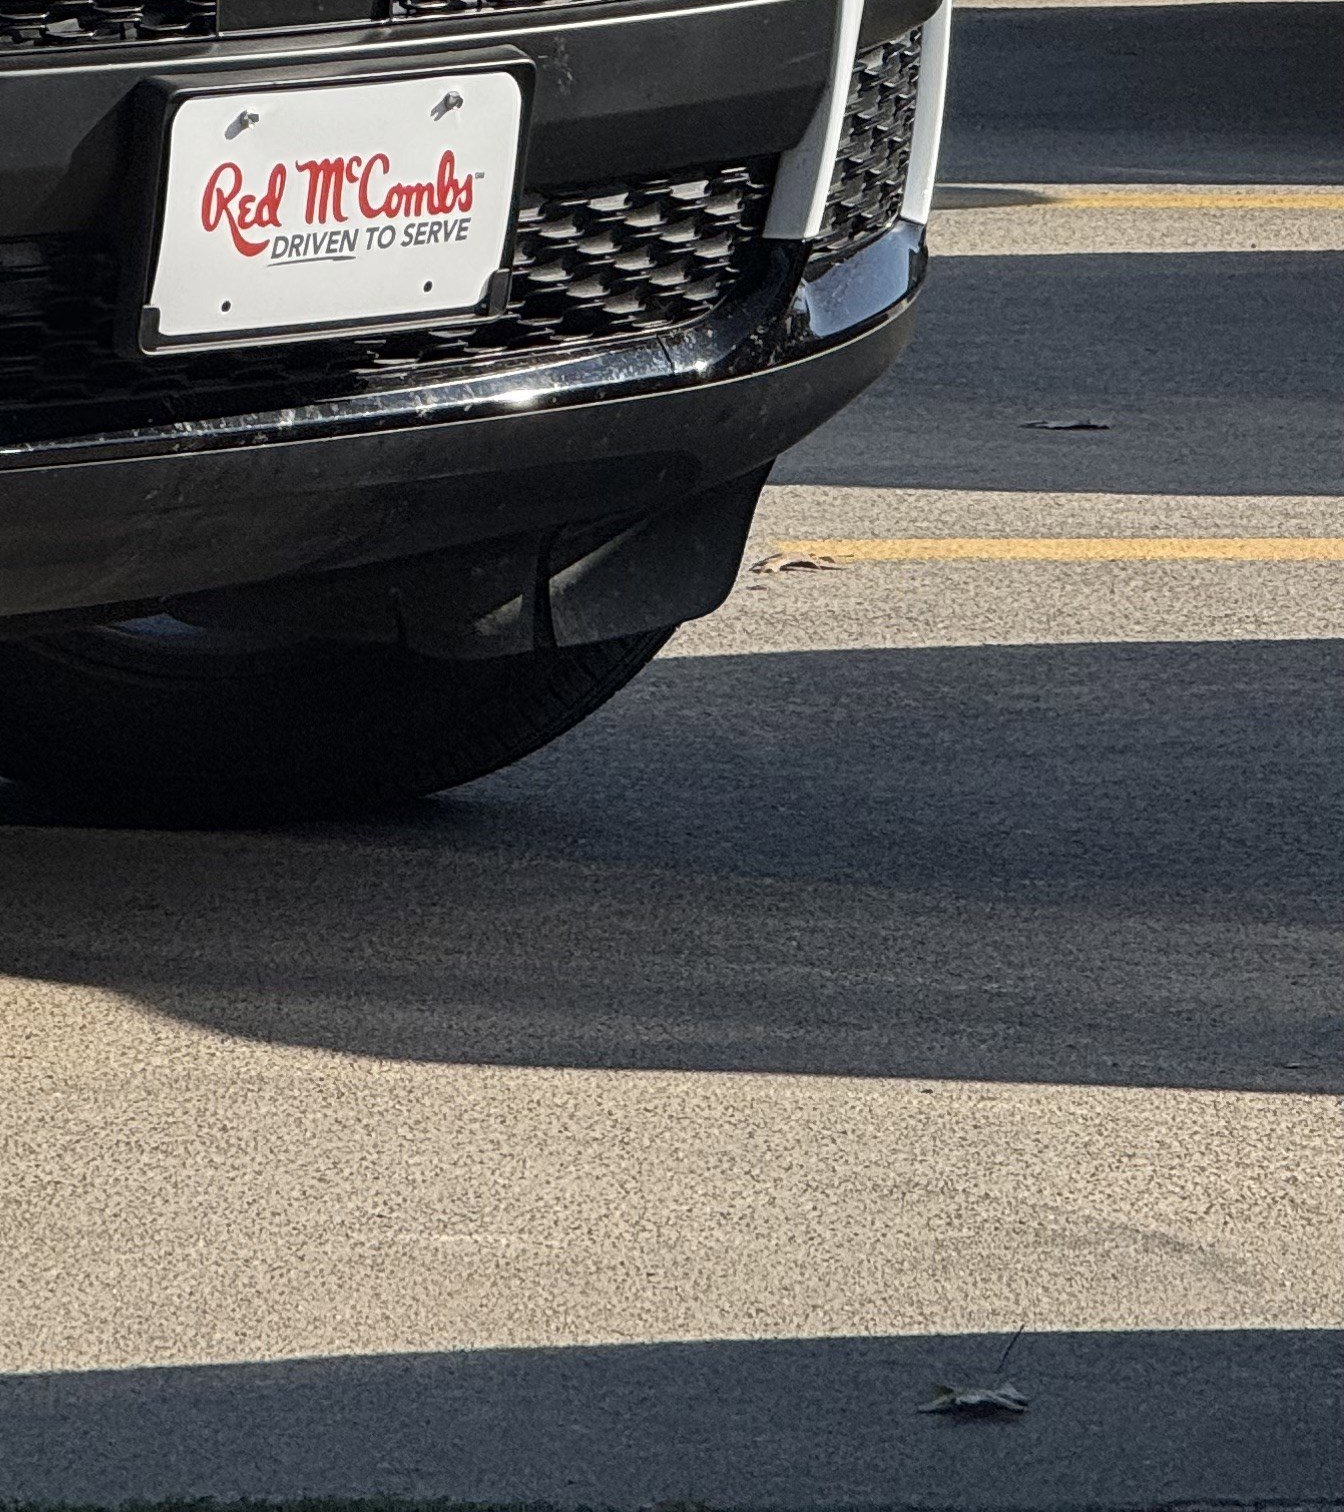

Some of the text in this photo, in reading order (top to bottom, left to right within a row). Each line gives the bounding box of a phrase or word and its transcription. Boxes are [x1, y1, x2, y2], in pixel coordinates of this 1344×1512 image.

[201, 149, 474, 257] Red McCombs
[270, 217, 472, 260] DRIVEN TO SERVE
